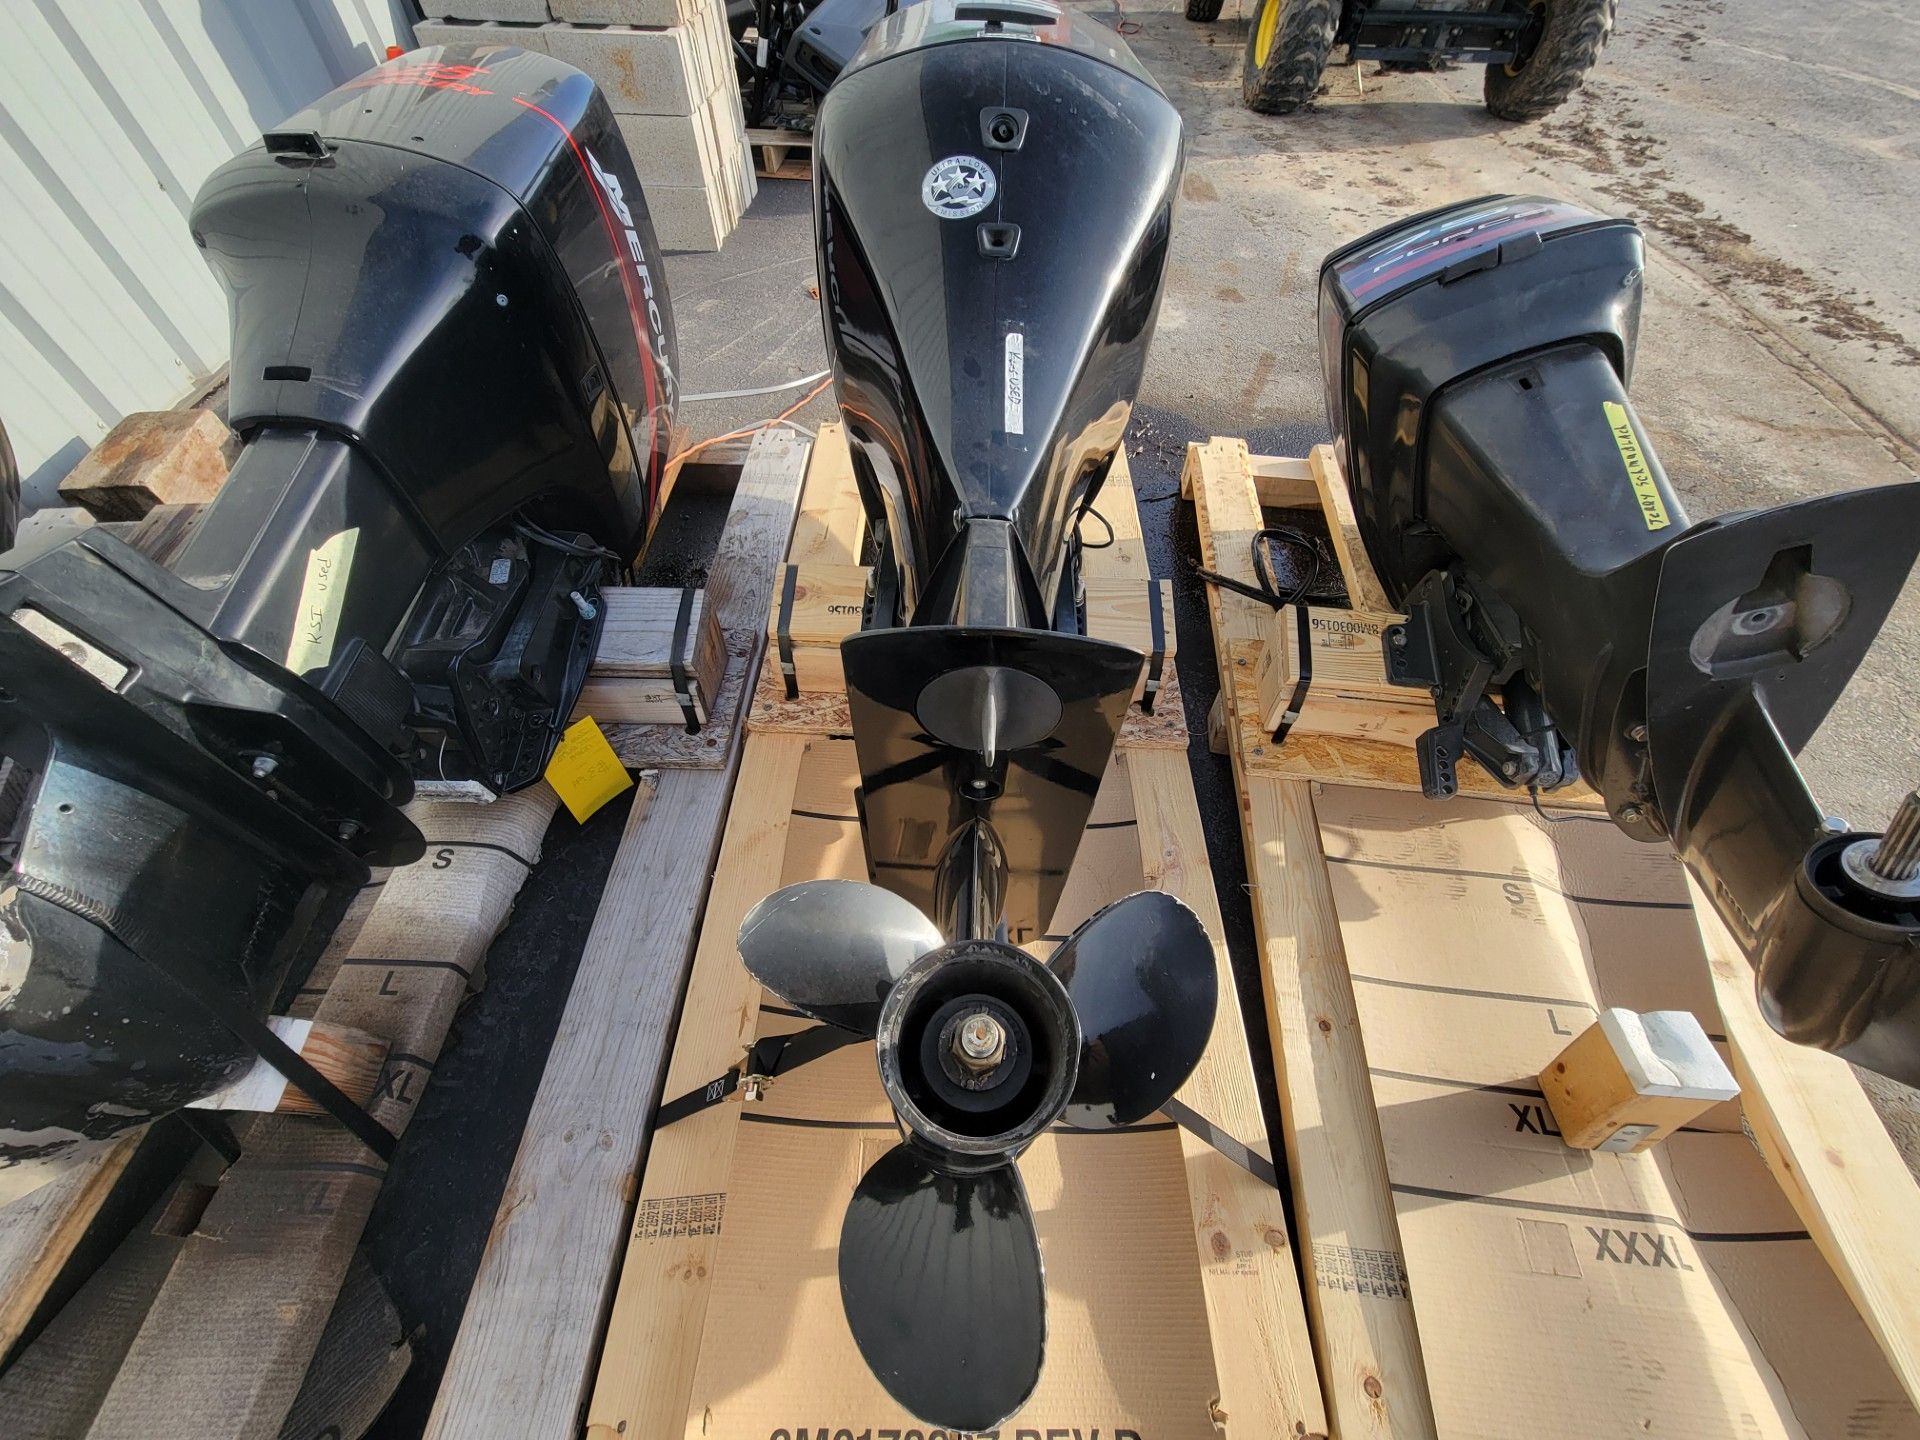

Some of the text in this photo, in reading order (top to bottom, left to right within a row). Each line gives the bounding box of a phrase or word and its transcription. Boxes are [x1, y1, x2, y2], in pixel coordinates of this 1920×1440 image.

[931, 158, 988, 176] ULTRA LOW
[1311, 618, 1379, 635] 8M0030156
[432, 848, 455, 869] S
[1502, 882, 1525, 904] S
[378, 971, 399, 996] L
[1547, 1009, 1572, 1036] L
[372, 1068, 413, 1105] XL
[1509, 1103, 1561, 1137] XL
[1585, 1225, 1695, 1272] XXXL
